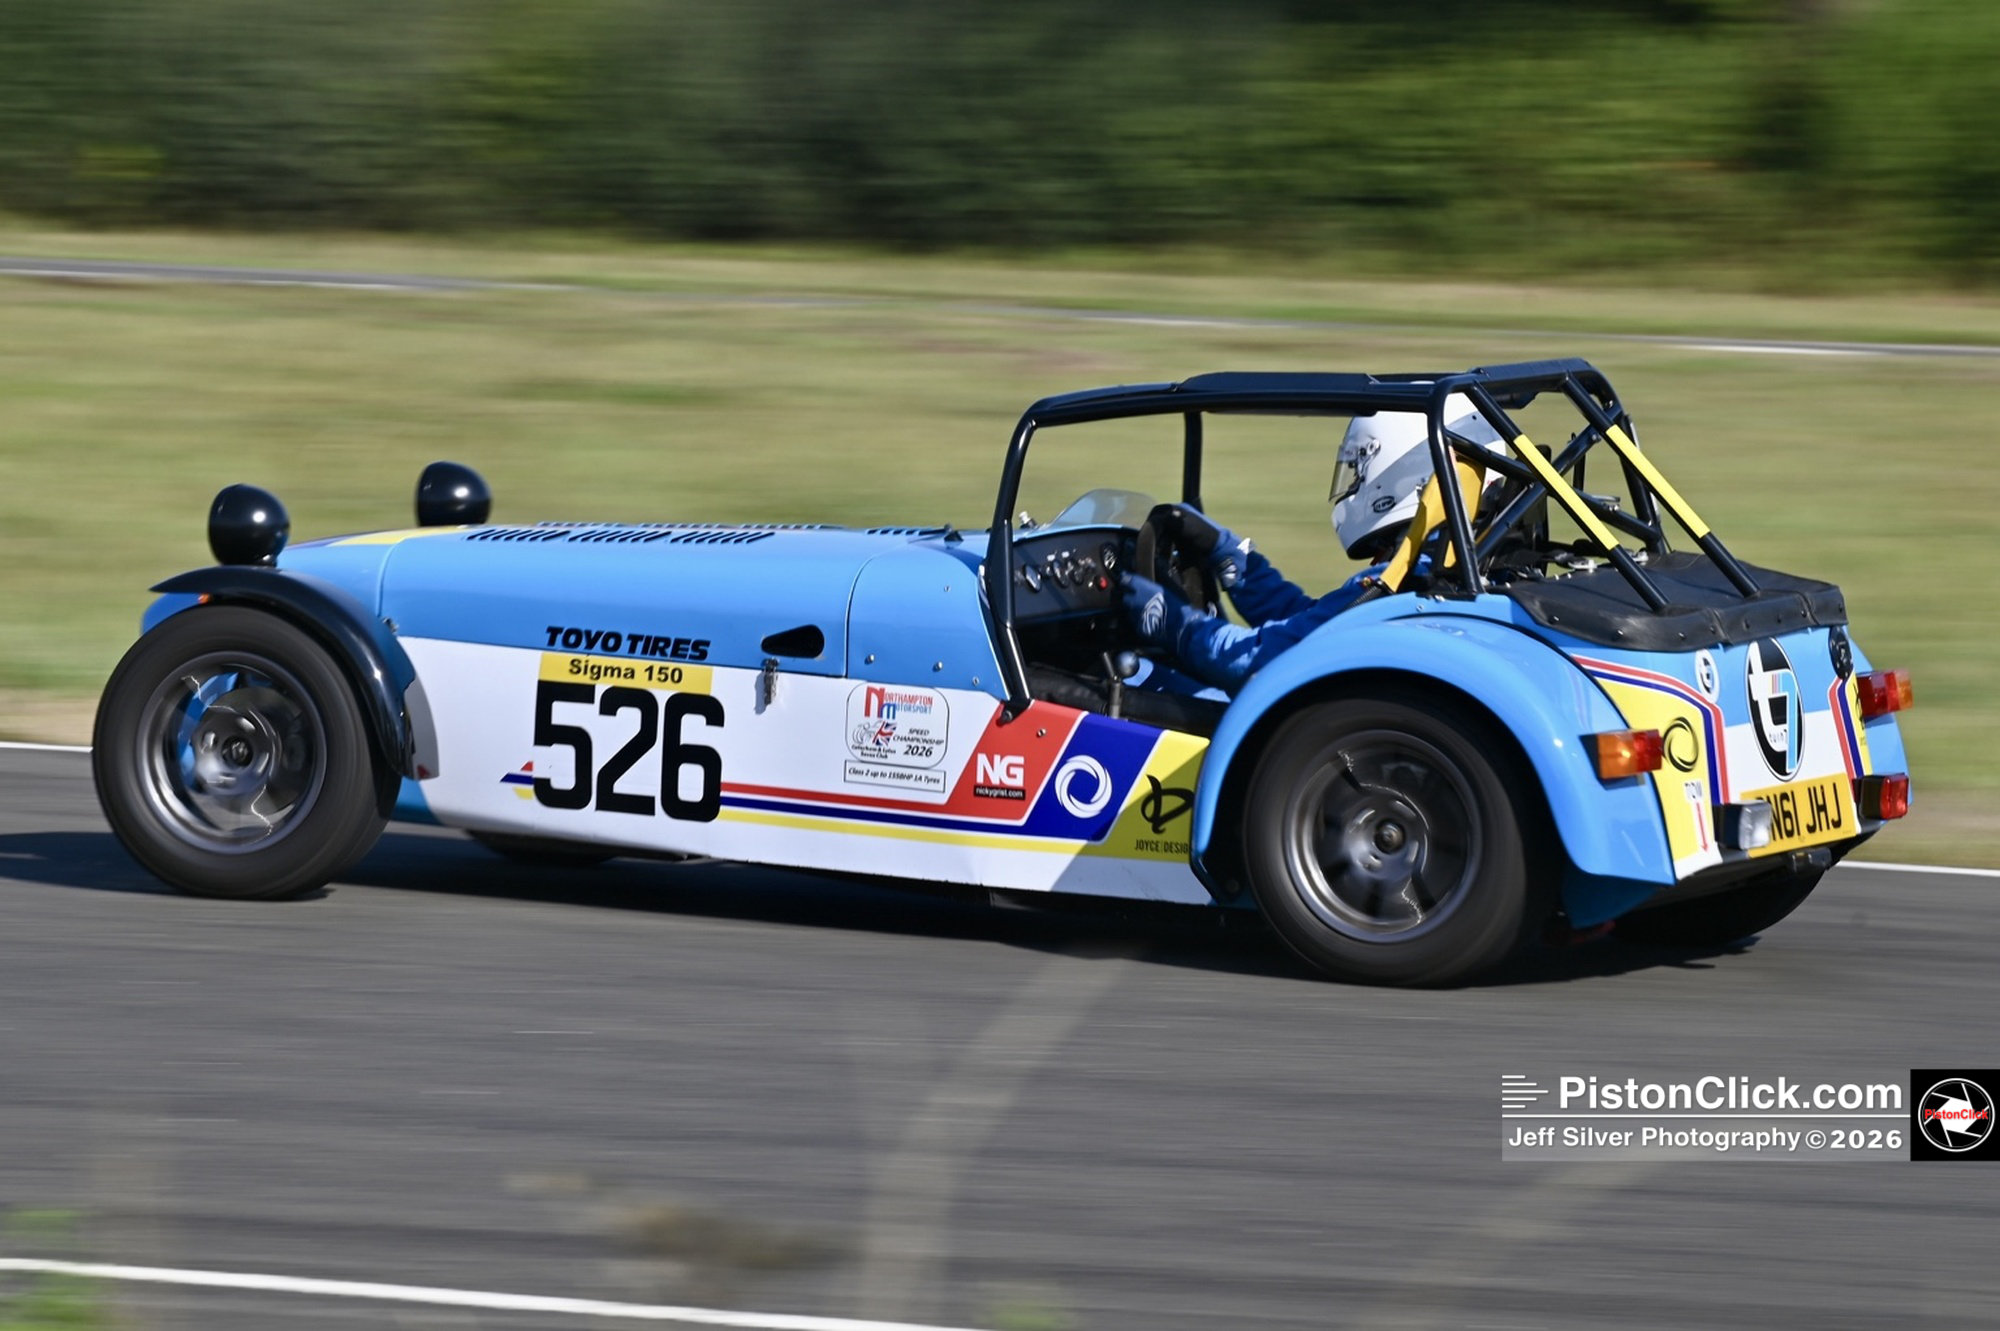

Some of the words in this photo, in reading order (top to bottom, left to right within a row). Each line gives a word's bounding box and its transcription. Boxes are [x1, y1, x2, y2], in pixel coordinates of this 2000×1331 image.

[546, 626, 622, 653] TOYO
[627, 634, 711, 661] TIRES
[569, 658, 636, 680] Sigma
[643, 665, 683, 684] 150
[864, 686, 933, 718] NORTHAMPTON
[881, 702, 932, 720] MOTORSPORT
[533, 679, 725, 823] 526
[903, 745, 933, 757] 2026
[976, 752, 1025, 787] NG
[975, 786, 1023, 799] nickygrist.com
[1756, 790, 1801, 841] N61
[1806, 782, 1842, 834] JHJ
[1163, 841, 1189, 854] DESIG
